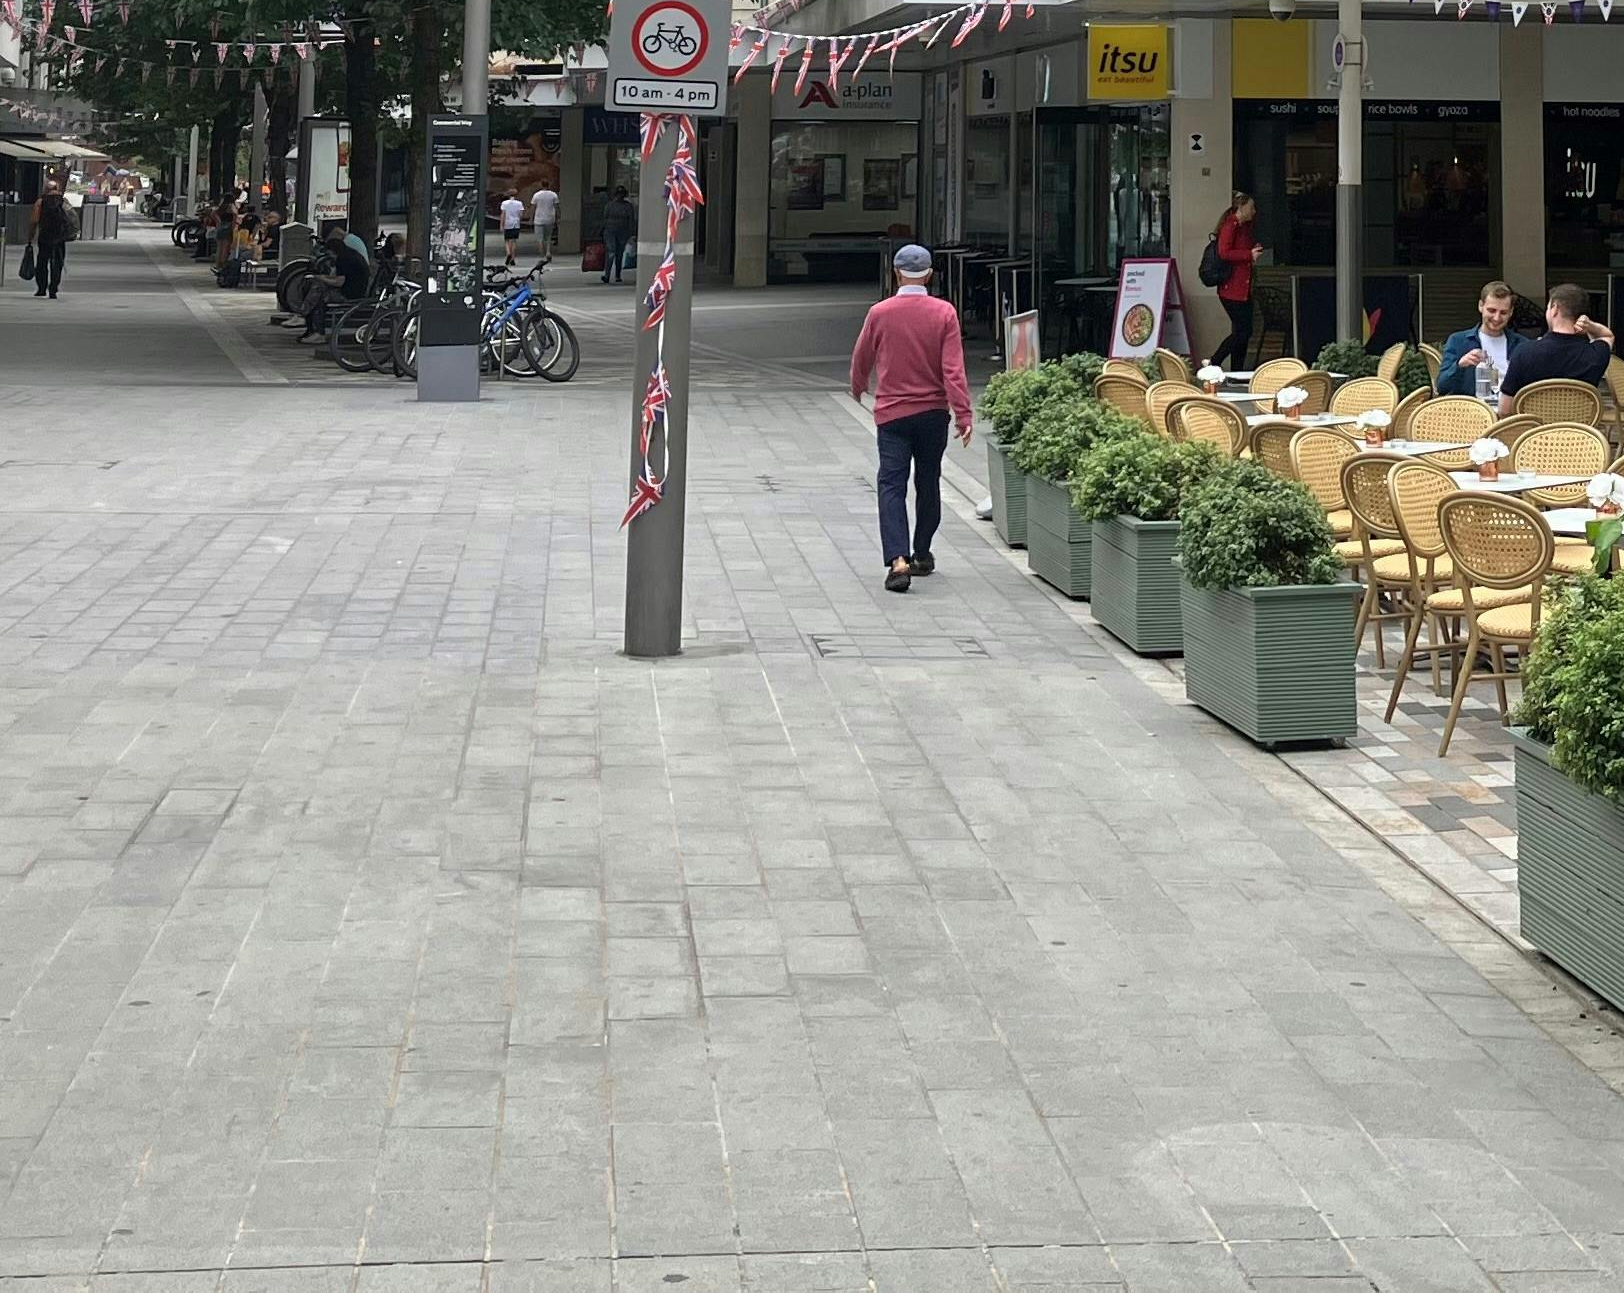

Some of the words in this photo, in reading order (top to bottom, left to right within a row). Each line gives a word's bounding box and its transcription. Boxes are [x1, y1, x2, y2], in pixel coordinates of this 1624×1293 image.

[1099, 43, 1158, 73] itsu
[621, 86, 638, 98] 10
[642, 89, 663, 99] am
[675, 88, 684, 99] 4
[688, 90, 710, 102] pm
[843, 82, 892, 100] a-plan
[843, 99, 892, 109] insurance
[1270, 103, 1296, 113] sushi
[1368, 103, 1387, 114] rice
[1388, 103, 1418, 114] bowls
[1438, 105, 1468, 117] gyoza
[1563, 106, 1580, 117] hot
[1581, 106, 1620, 118] noodles
[1565, 148, 1596, 198] iu
